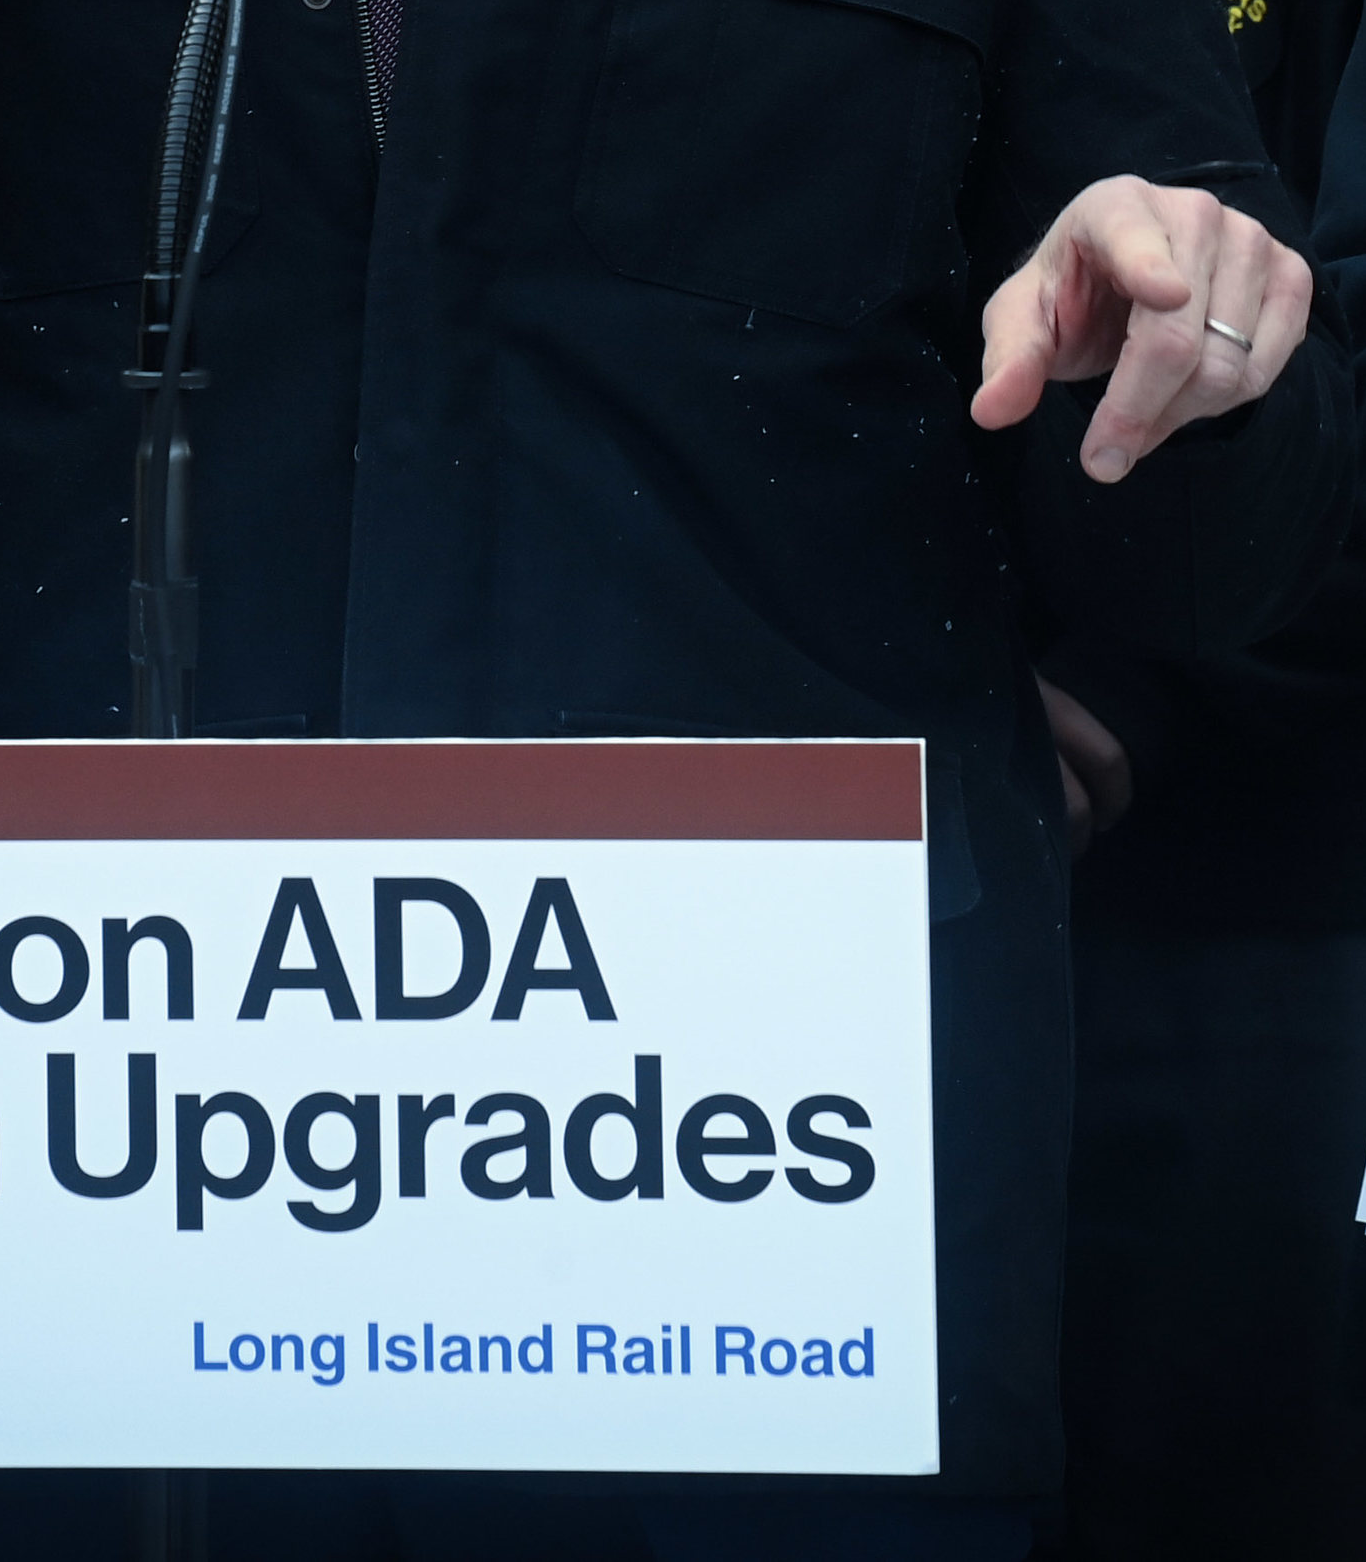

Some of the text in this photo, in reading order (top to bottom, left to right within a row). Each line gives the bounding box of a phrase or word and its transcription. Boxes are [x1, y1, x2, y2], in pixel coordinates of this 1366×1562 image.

[236, 877, 618, 1021] ADA
[46, 1053, 876, 1233] Upgrades
[193, 1321, 875, 1387] Long Island Rail Road
